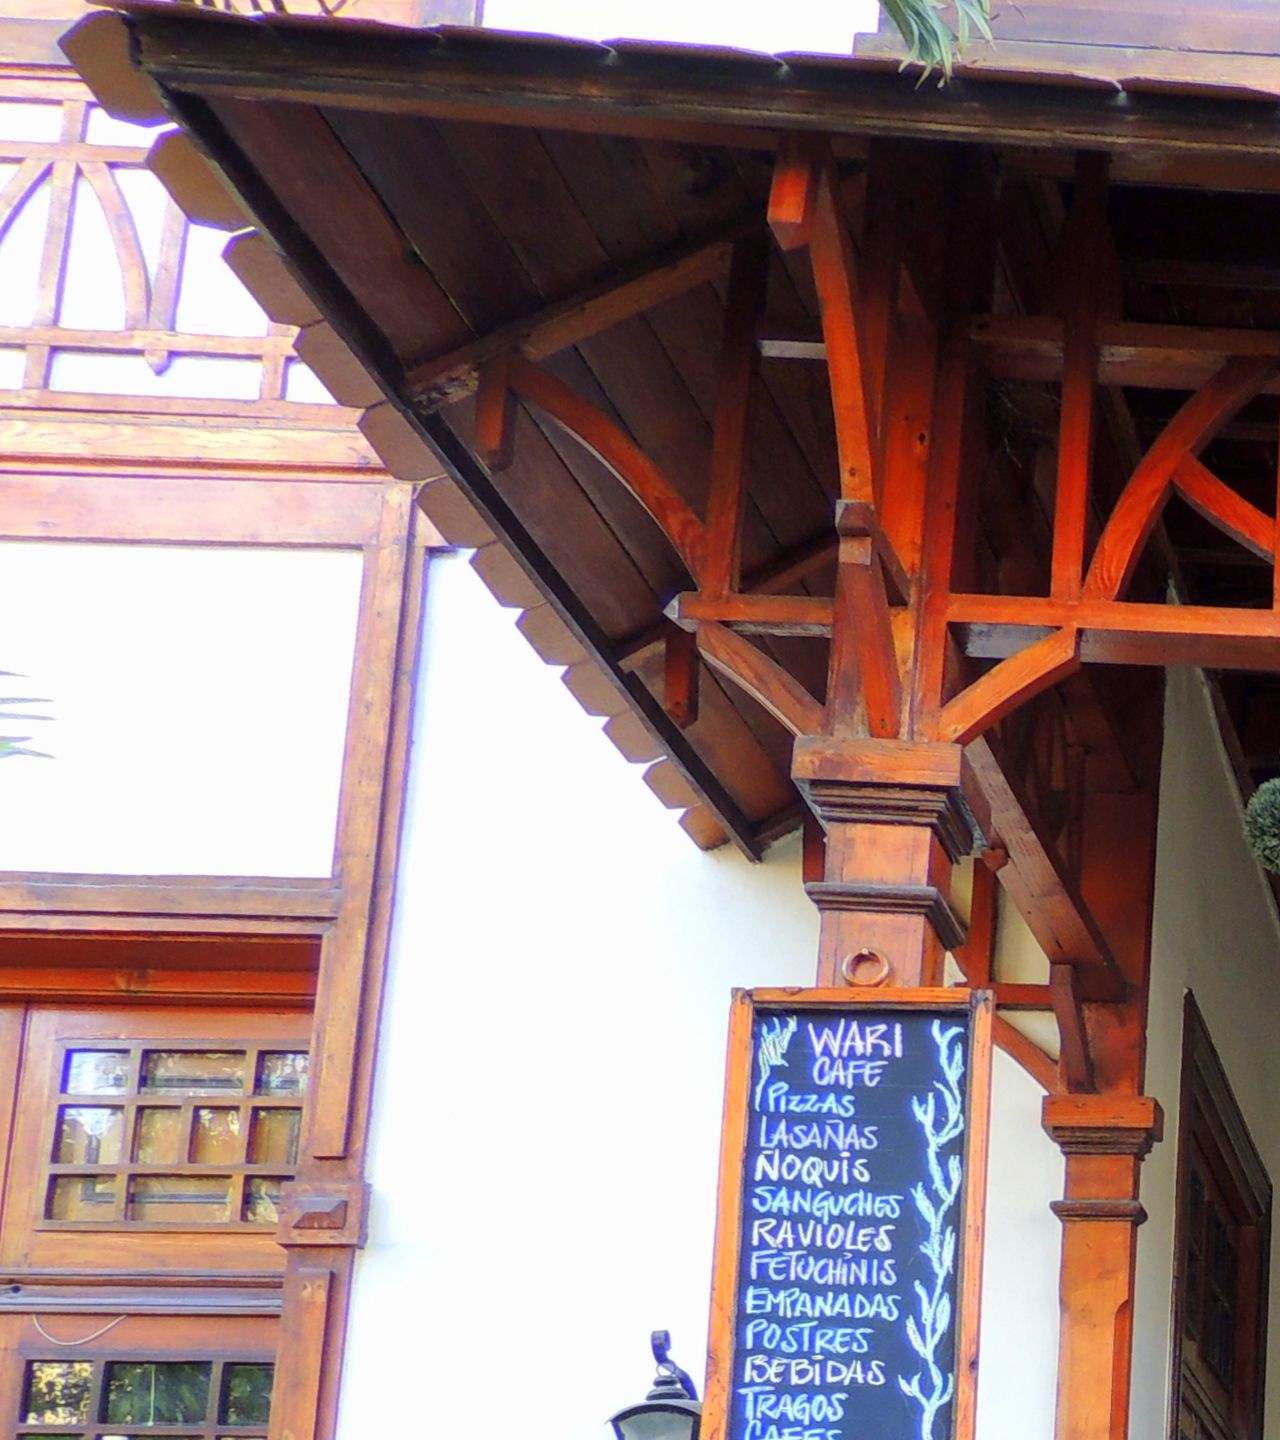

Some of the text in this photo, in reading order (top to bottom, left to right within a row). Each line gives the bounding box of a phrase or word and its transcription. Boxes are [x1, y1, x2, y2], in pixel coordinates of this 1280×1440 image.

[808, 1017, 903, 1058] WARI
[812, 1055, 889, 1089] CAFE
[759, 1117, 879, 1151] LASAÑAS
[751, 1185, 904, 1224] SANGUCHES
[752, 1218, 896, 1252] RAVIOLES
[745, 1286, 902, 1322] EMPANADAS
[745, 1318, 875, 1354] POSTRES
[744, 1354, 887, 1386] BEBIDAS
[737, 1386, 848, 1423] TRAGOS
